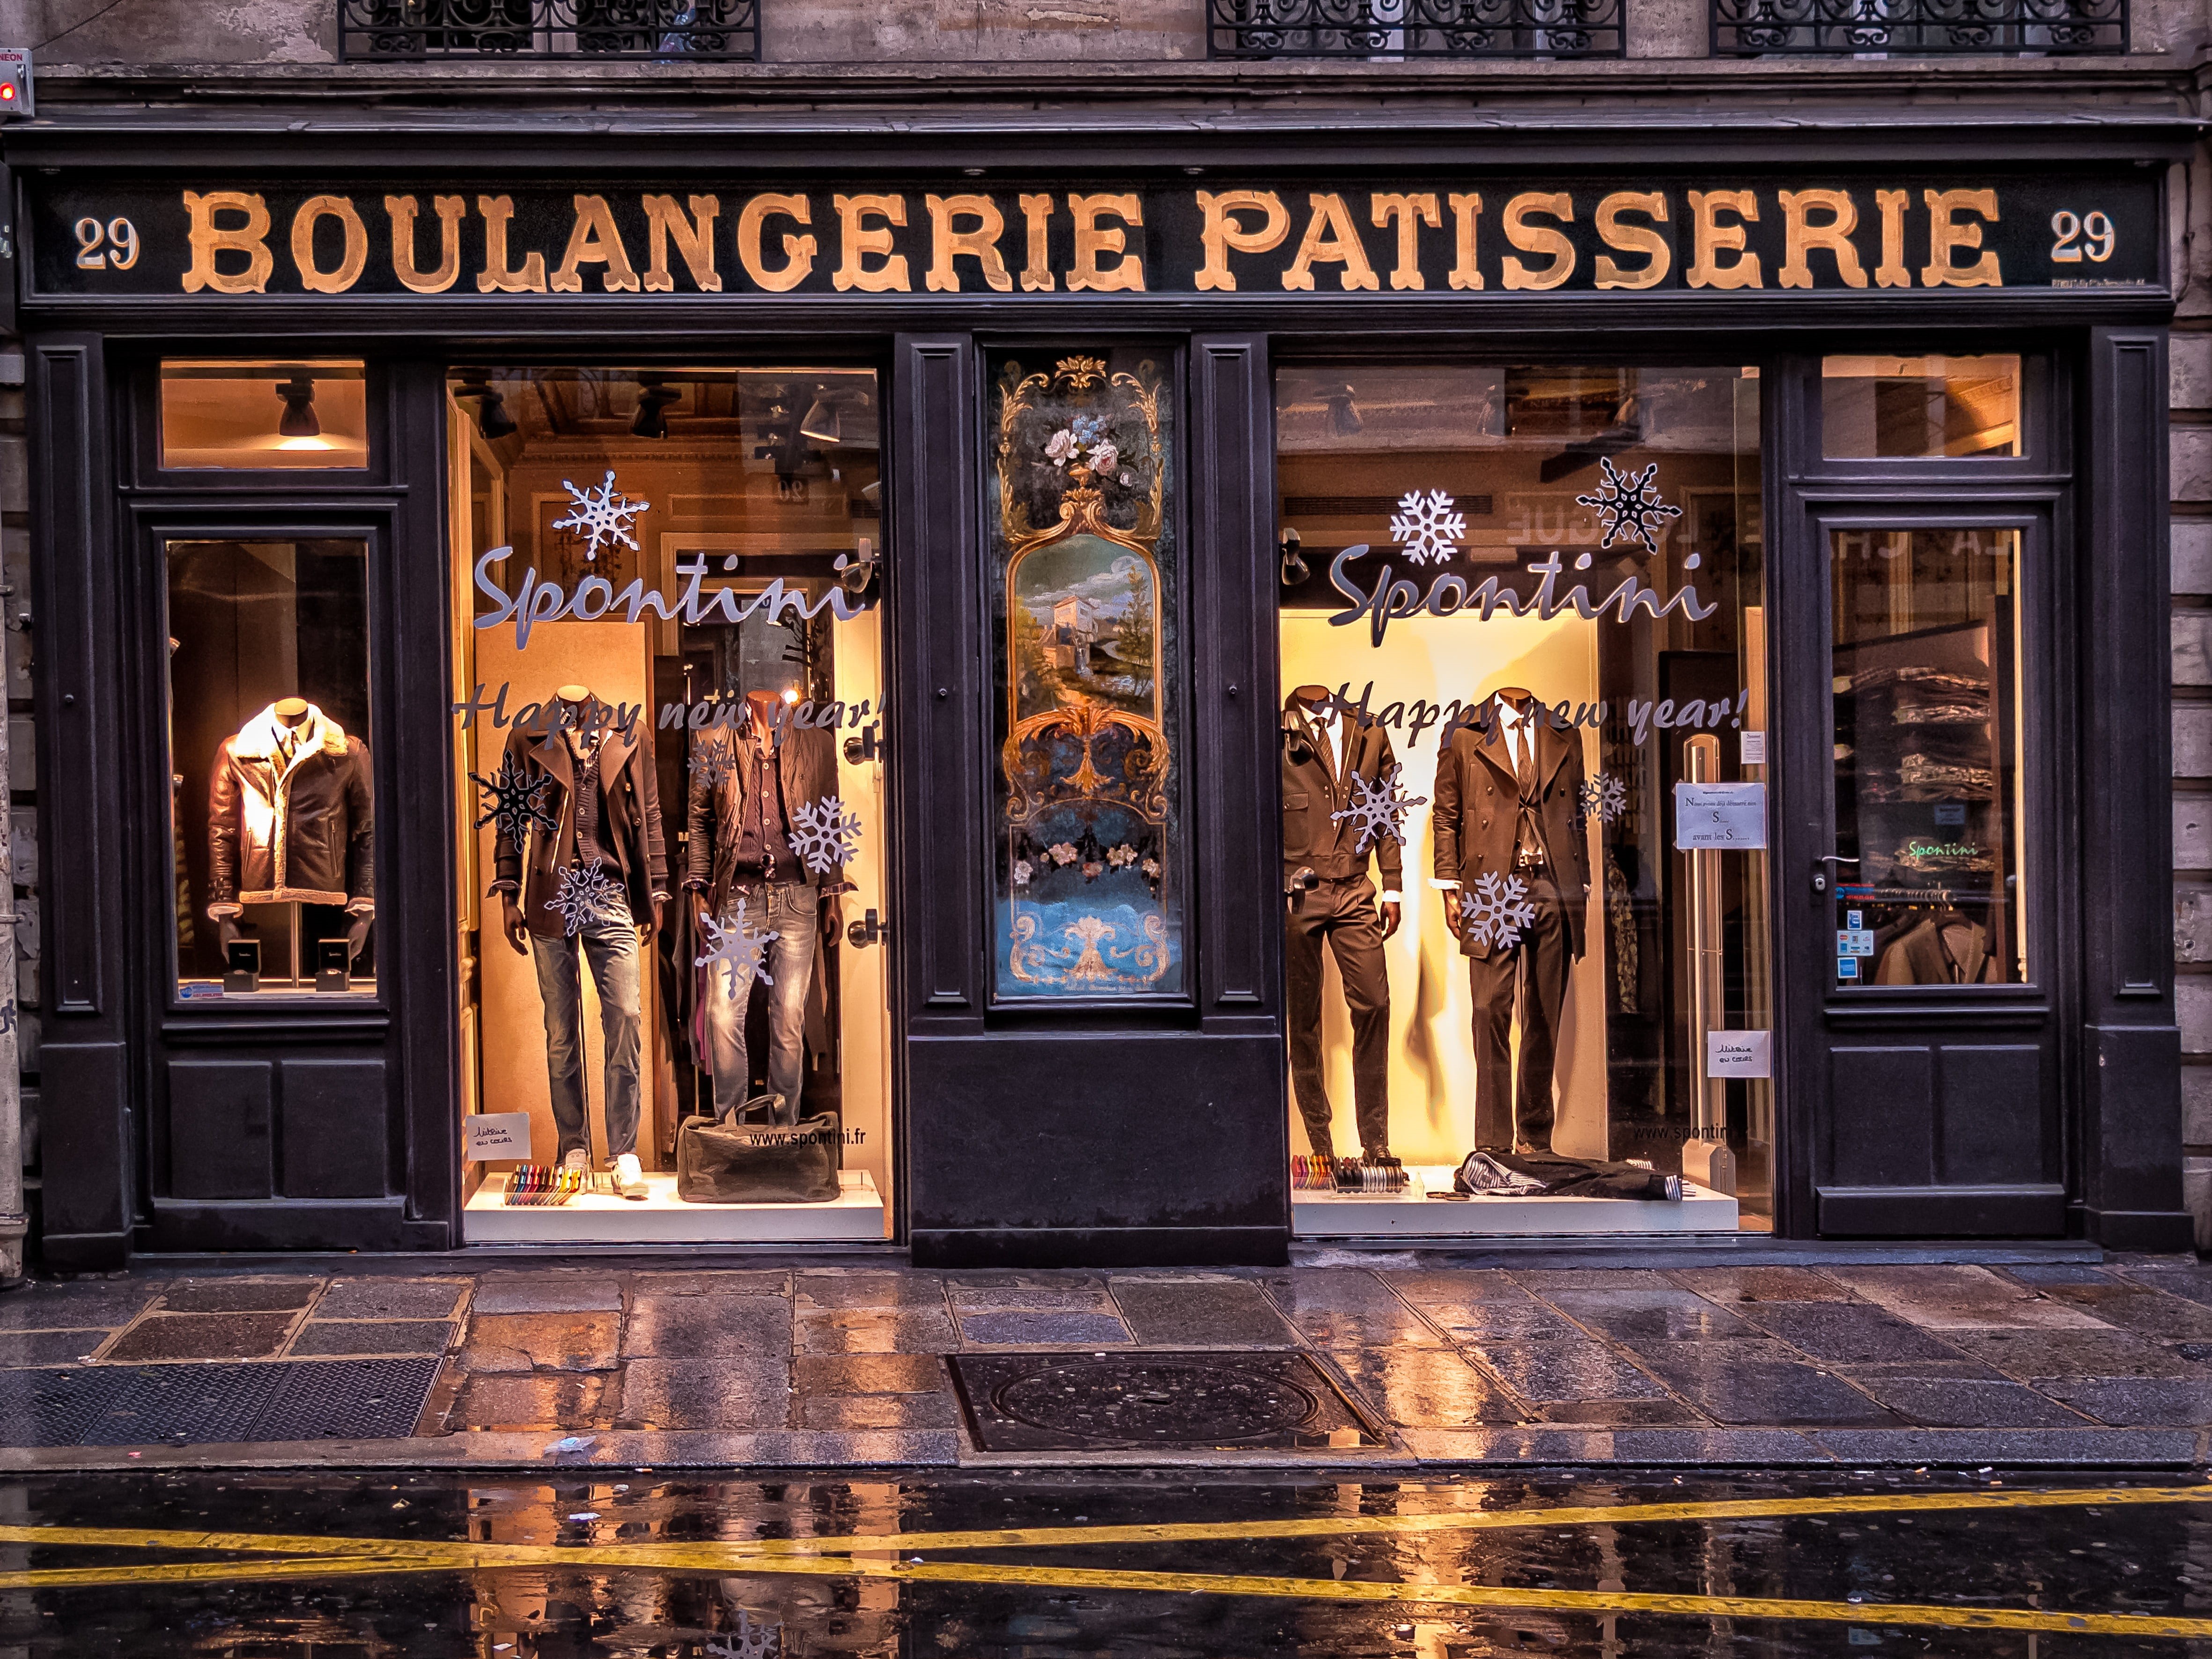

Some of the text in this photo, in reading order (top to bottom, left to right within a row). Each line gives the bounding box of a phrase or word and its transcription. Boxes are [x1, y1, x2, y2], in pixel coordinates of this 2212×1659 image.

[75, 217, 140, 270] 29
[182, 190, 2002, 294] BOULANGERIE PATISSERIE
[2051, 211, 2115, 262] 29
[474, 546, 866, 650] Spontini
[1328, 544, 1718, 648] Spontini
[451, 681, 885, 750] Happy new year!
[1312, 681, 1748, 749] Happy new year!
[1909, 841, 1978, 860] Spontini
[750, 1128, 866, 1149] www.spontini.fr
